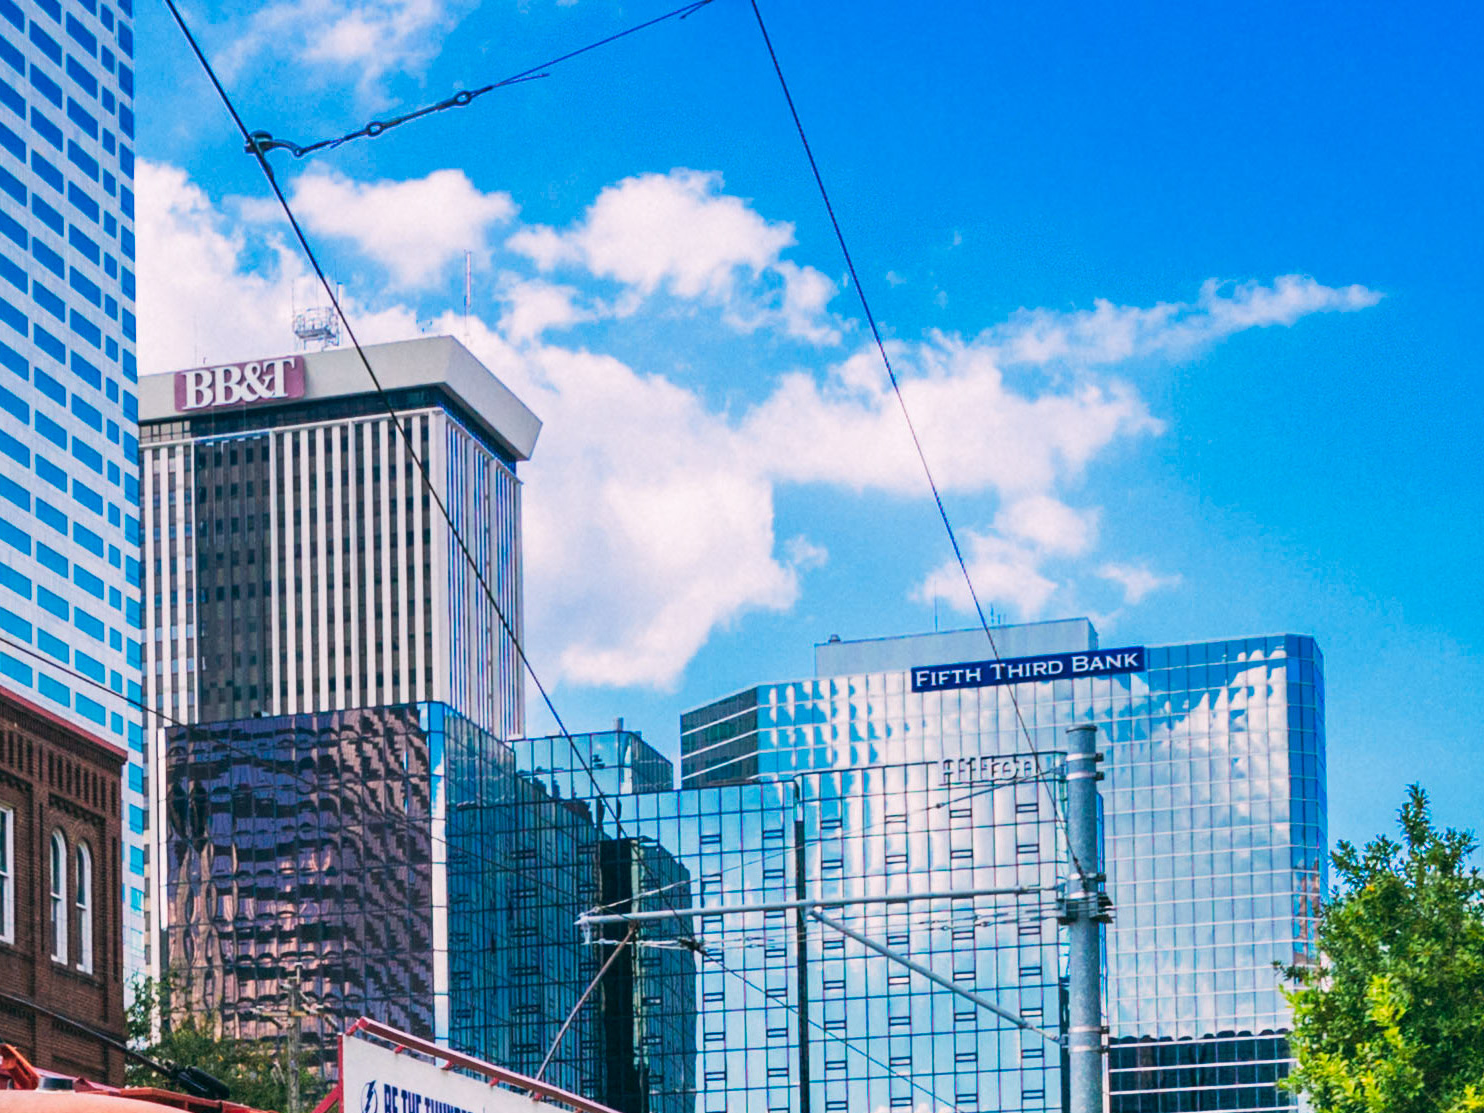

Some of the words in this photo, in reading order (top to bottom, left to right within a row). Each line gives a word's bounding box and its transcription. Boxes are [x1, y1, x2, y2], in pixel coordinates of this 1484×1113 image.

[181, 357, 296, 411] BB&T
[915, 667, 982, 687] FIFTH
[990, 659, 1064, 680] THIRD
[1071, 652, 1139, 673] BANK
